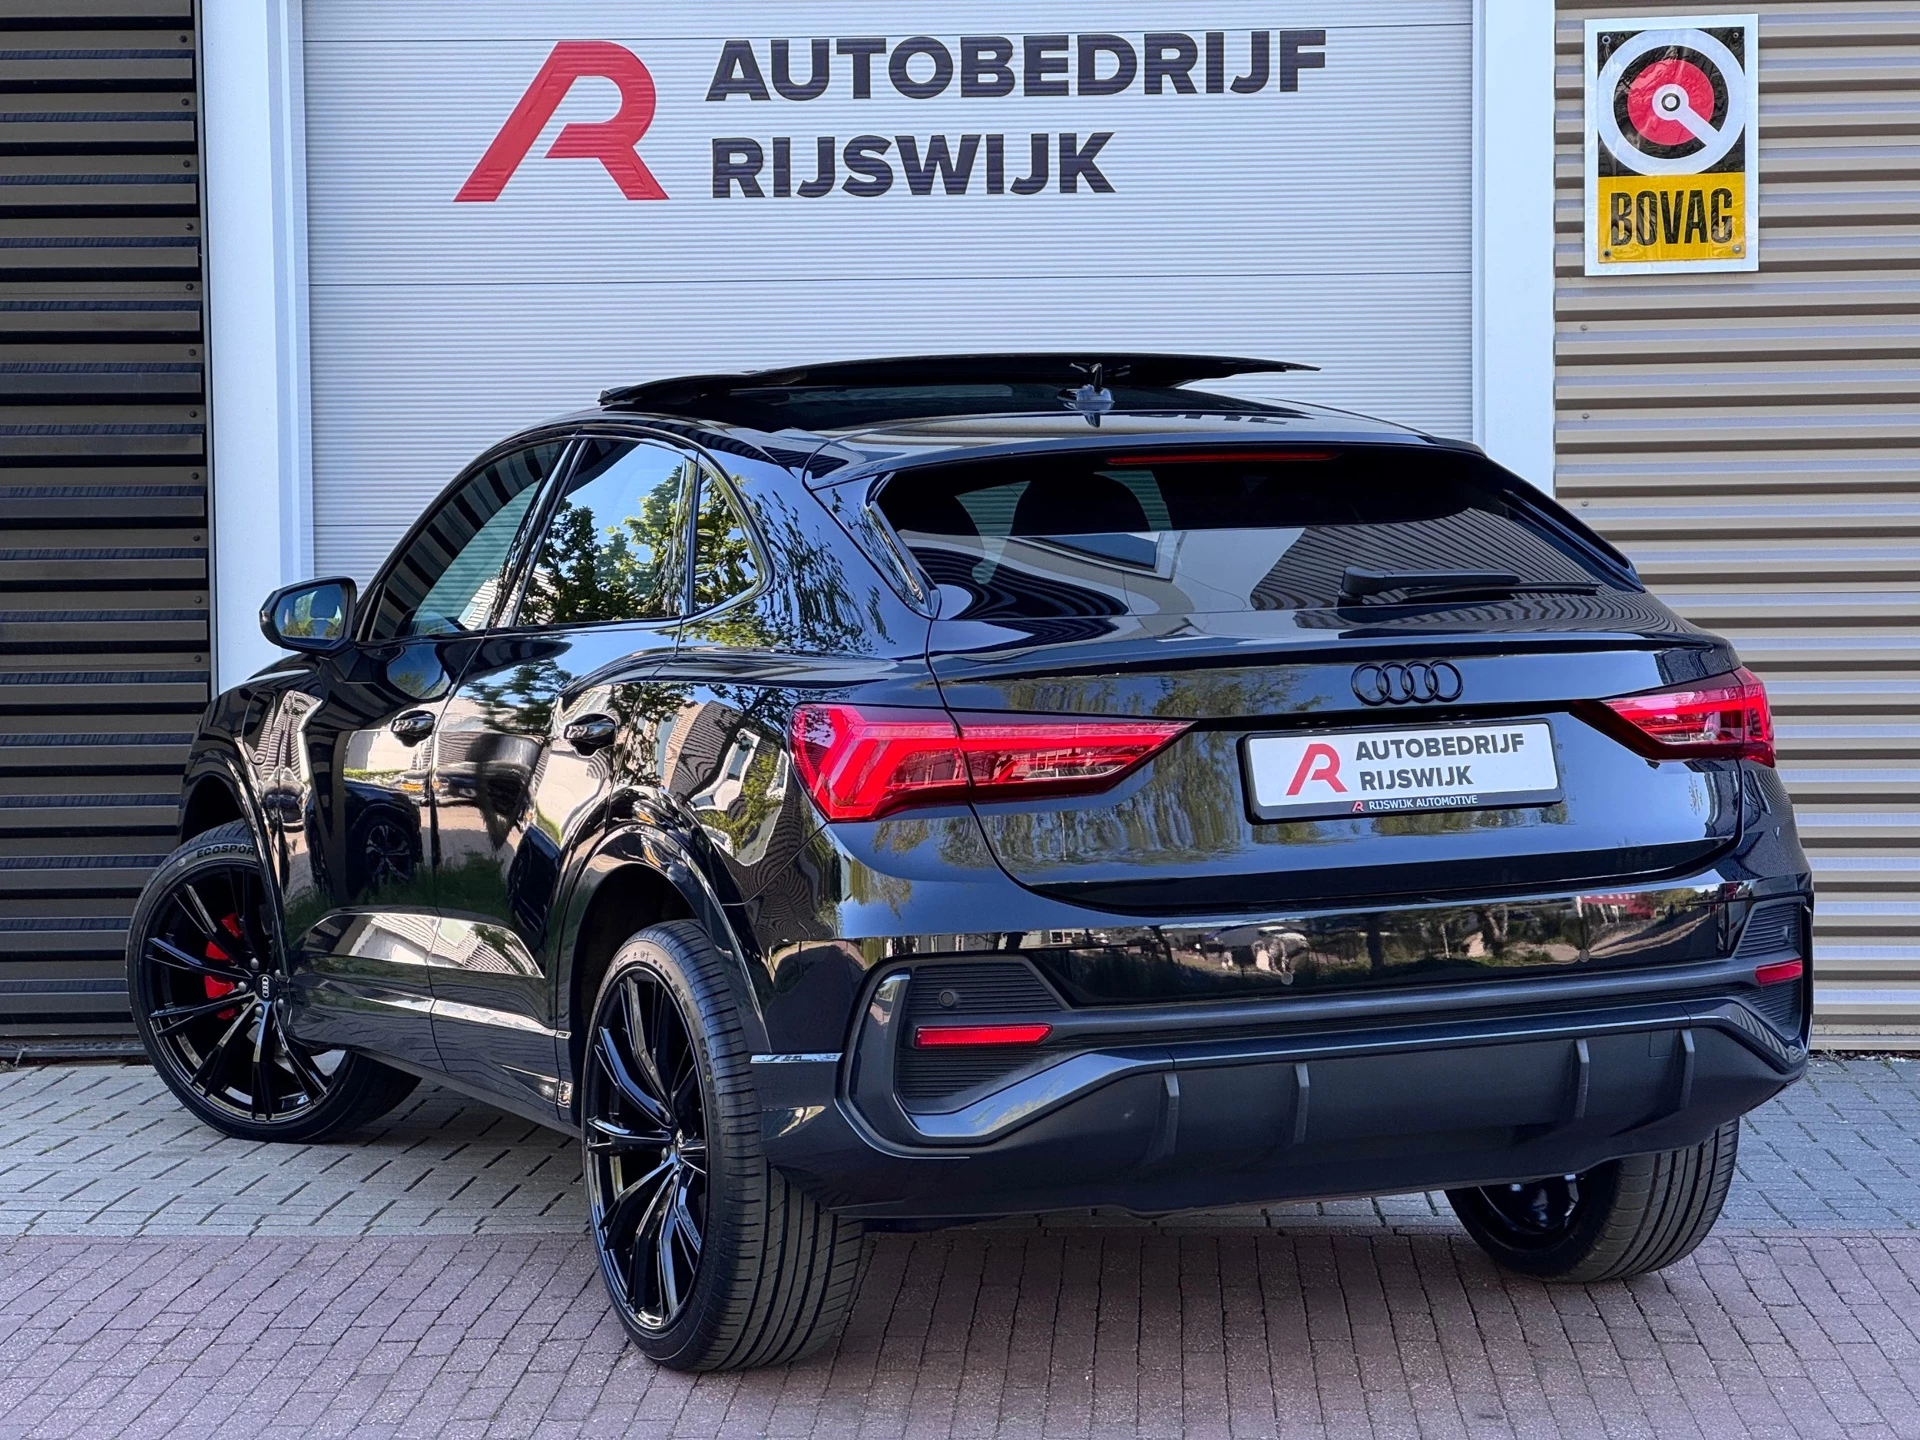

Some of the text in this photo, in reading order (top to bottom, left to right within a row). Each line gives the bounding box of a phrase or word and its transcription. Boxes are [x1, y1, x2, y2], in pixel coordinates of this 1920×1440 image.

[705, 29, 1327, 102] AUTOBEDRIJF
[712, 131, 1116, 200] RIJSWIJK
[1610, 187, 1733, 247] BOVAG
[1355, 732, 1525, 762] AUTOBEDRIJF
[1359, 765, 1474, 791] RIJSWIJK
[1368, 799, 1414, 810] RIJSWIJK
[1416, 794, 1478, 807] AUTOMOTIVE
[196, 844, 256, 859] ECOSPOR
